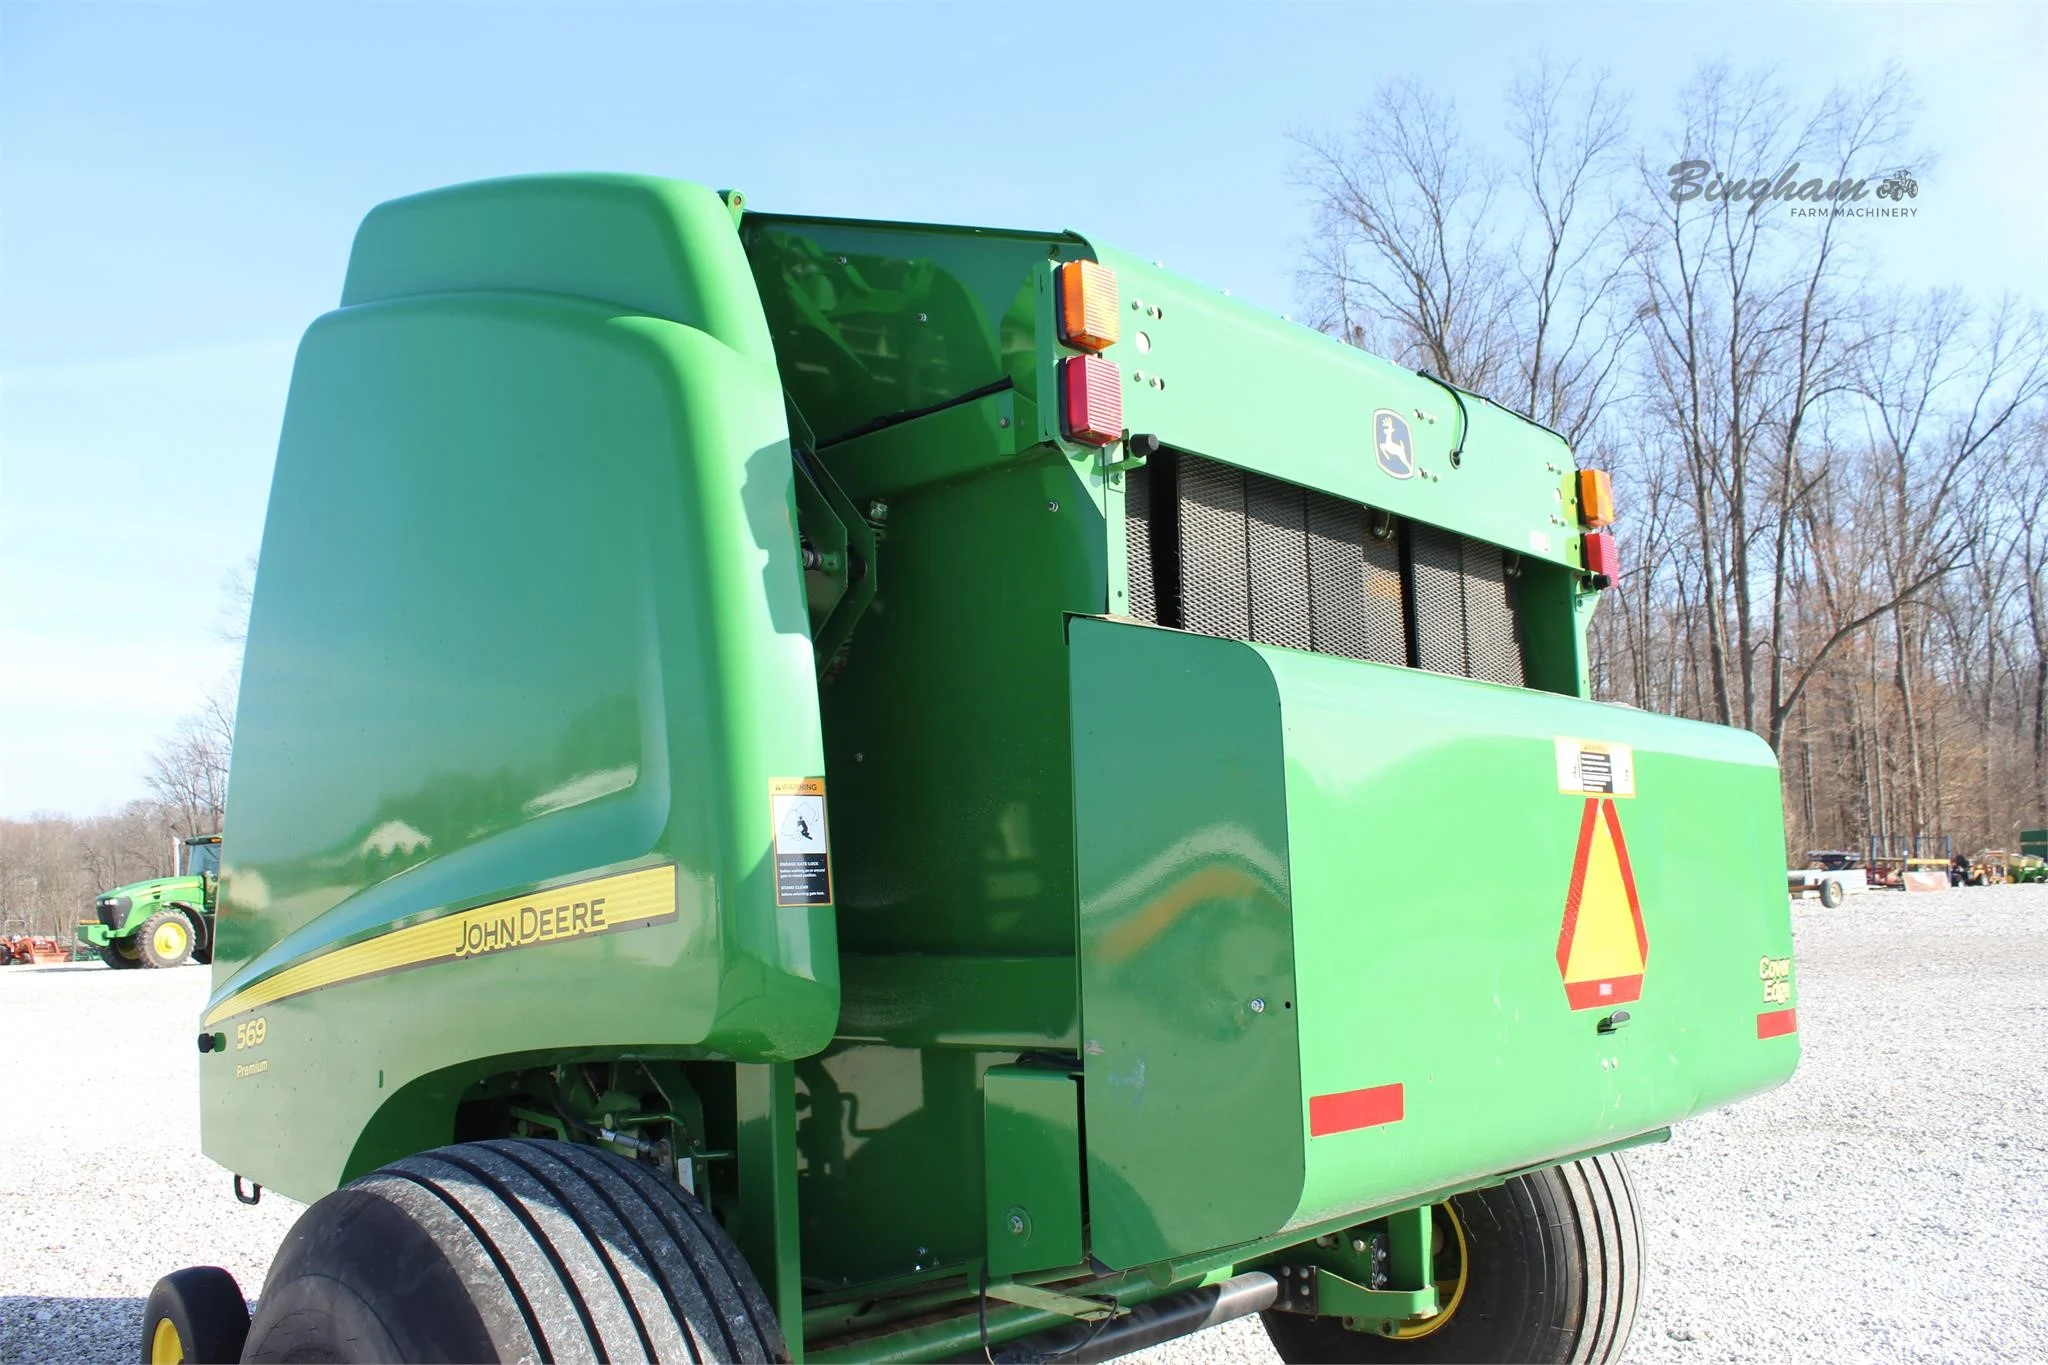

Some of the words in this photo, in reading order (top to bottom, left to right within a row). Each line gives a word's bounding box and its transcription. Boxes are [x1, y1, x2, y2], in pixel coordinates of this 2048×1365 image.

[1759, 955, 1790, 981] Cover
[236, 1016, 267, 1050] 569
[236, 1060, 268, 1079] Premium
